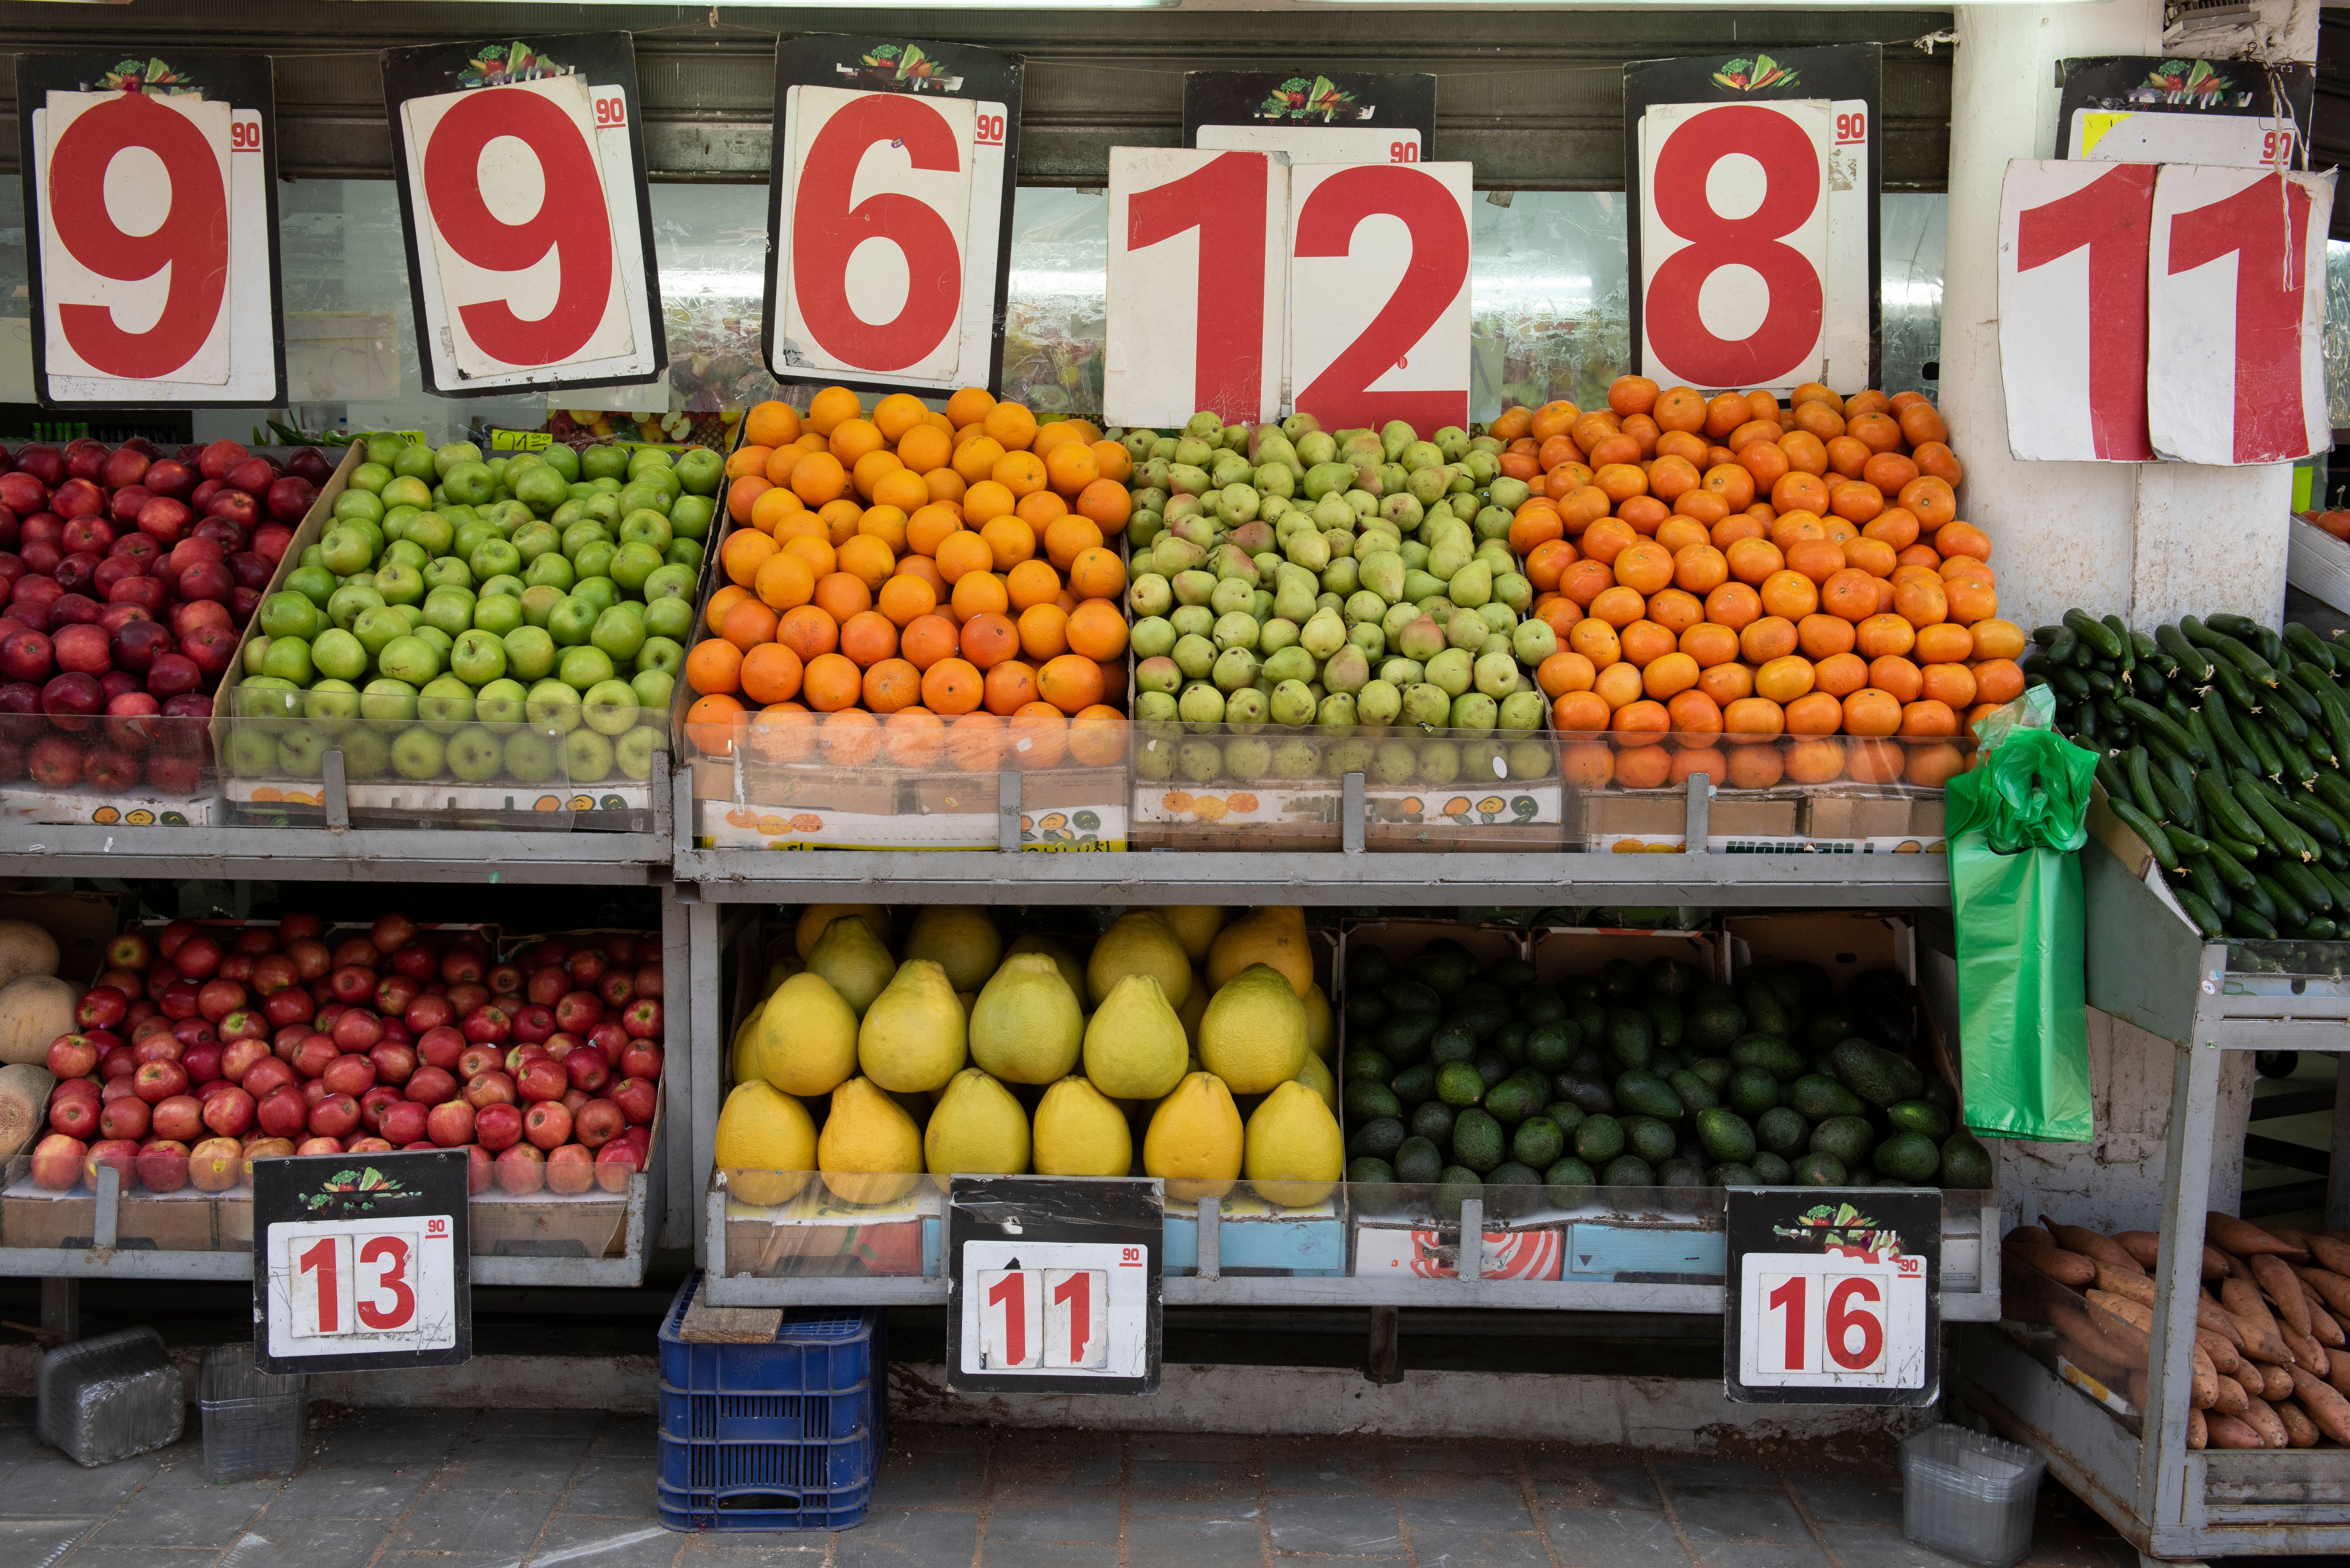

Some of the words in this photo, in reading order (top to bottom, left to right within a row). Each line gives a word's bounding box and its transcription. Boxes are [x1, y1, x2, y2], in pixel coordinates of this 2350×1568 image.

[49, 95, 228, 379] 9
[232, 122, 260, 147] 90
[424, 88, 612, 366] 9
[596, 98, 624, 123] 90
[793, 94, 961, 371] 6
[977, 114, 1004, 141] 90
[1127, 151, 1469, 442] 12
[1390, 142, 1418, 163] 90
[1645, 105, 1823, 387] 8
[1837, 113, 1865, 140] 90
[2018, 164, 2312, 463] 11
[2264, 132, 2292, 159] 90
[301, 1236, 415, 1332] 13
[428, 1219, 445, 1233] 90
[989, 1273, 1089, 1365] 11
[1123, 1248, 1140, 1261] 90
[1770, 1277, 1882, 1369] 16
[1902, 1259, 1918, 1272] 90
